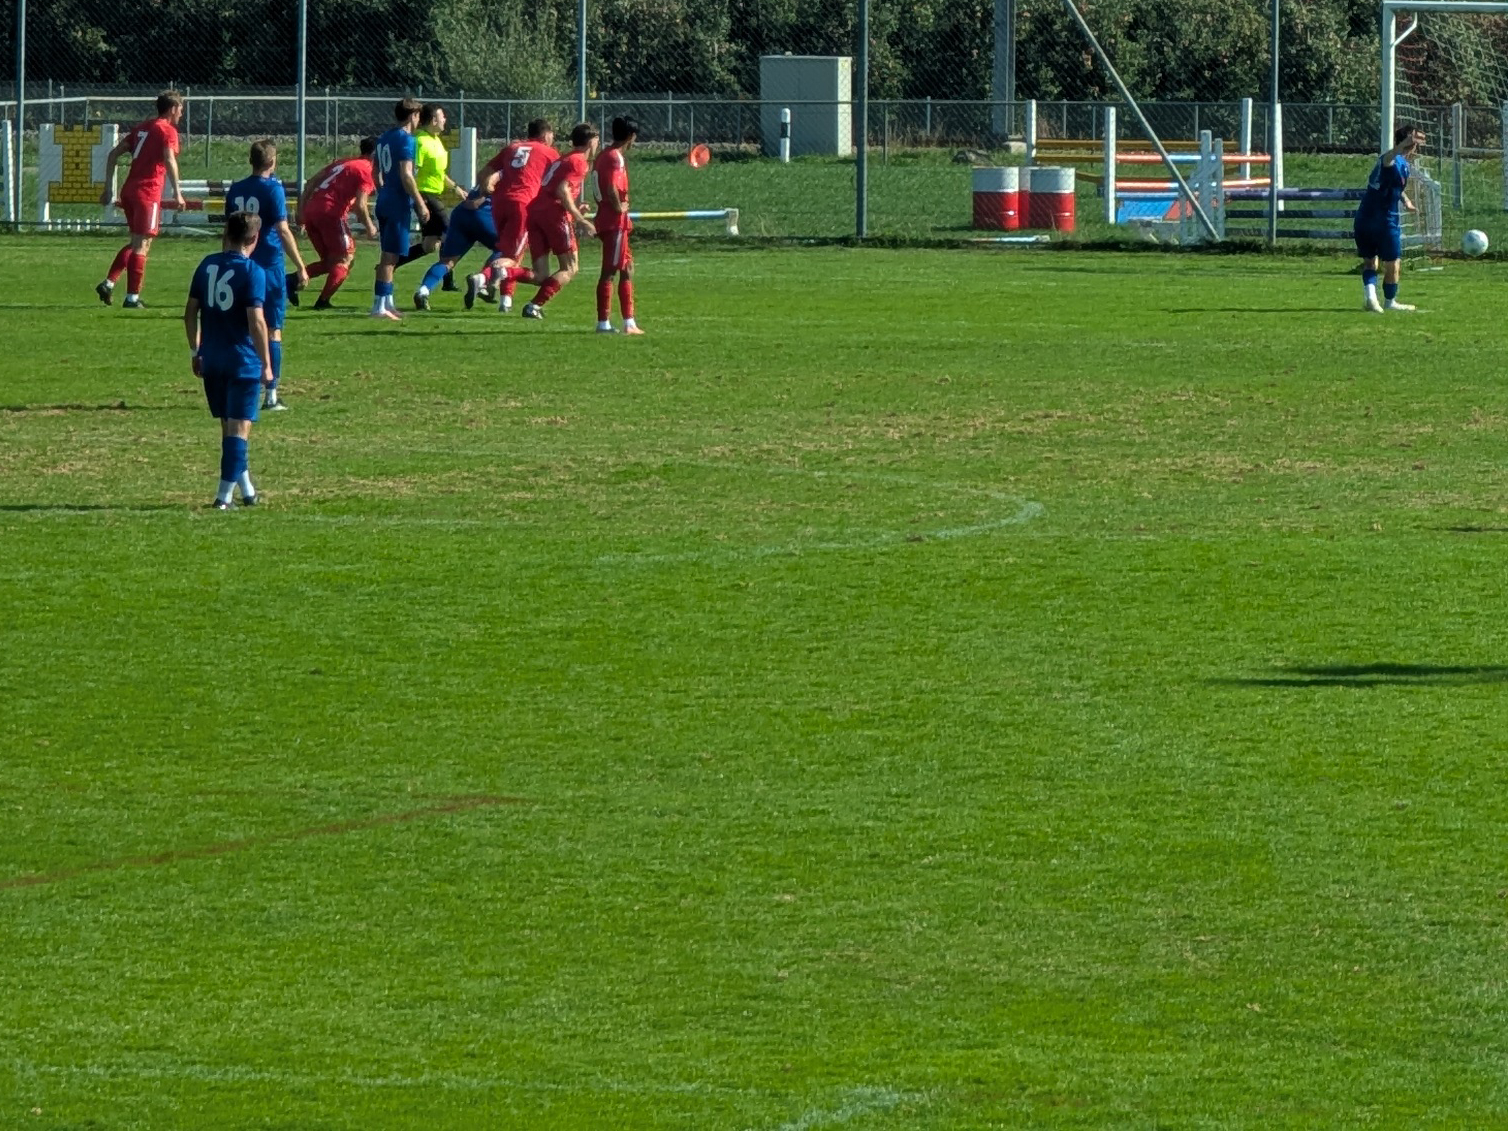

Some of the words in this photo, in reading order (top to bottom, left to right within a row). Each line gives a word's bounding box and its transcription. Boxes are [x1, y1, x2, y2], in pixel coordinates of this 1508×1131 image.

[133, 131, 149, 158] 7
[511, 146, 533, 168] 5
[376, 143, 392, 174] 10
[319, 163, 345, 189] 2
[206, 264, 236, 311] 16
